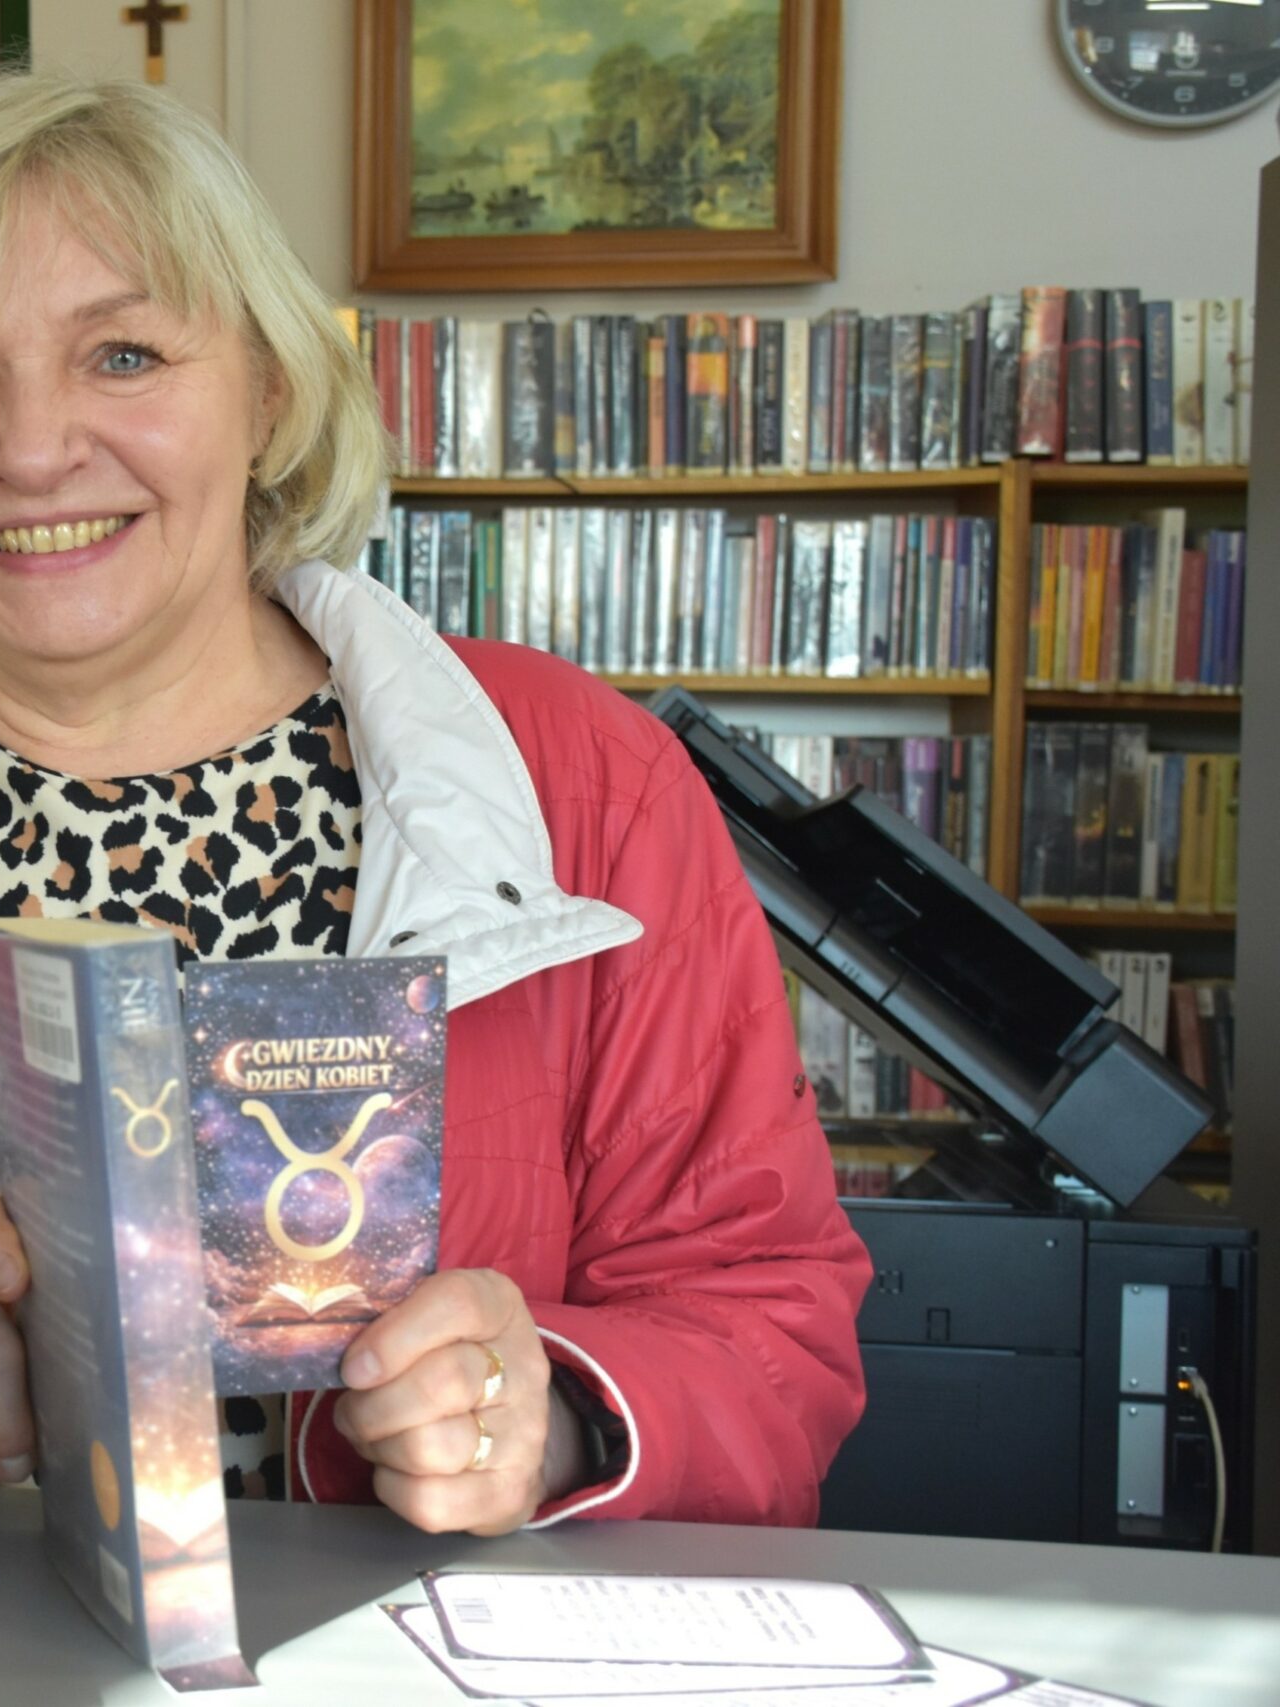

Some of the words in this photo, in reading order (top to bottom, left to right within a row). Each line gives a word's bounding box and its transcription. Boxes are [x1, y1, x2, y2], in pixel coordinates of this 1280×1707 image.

[252, 1035, 392, 1066] GWIEZDNY
[246, 1065, 311, 1092] DZIEŃ
[316, 1064, 394, 1089] KOBIET
